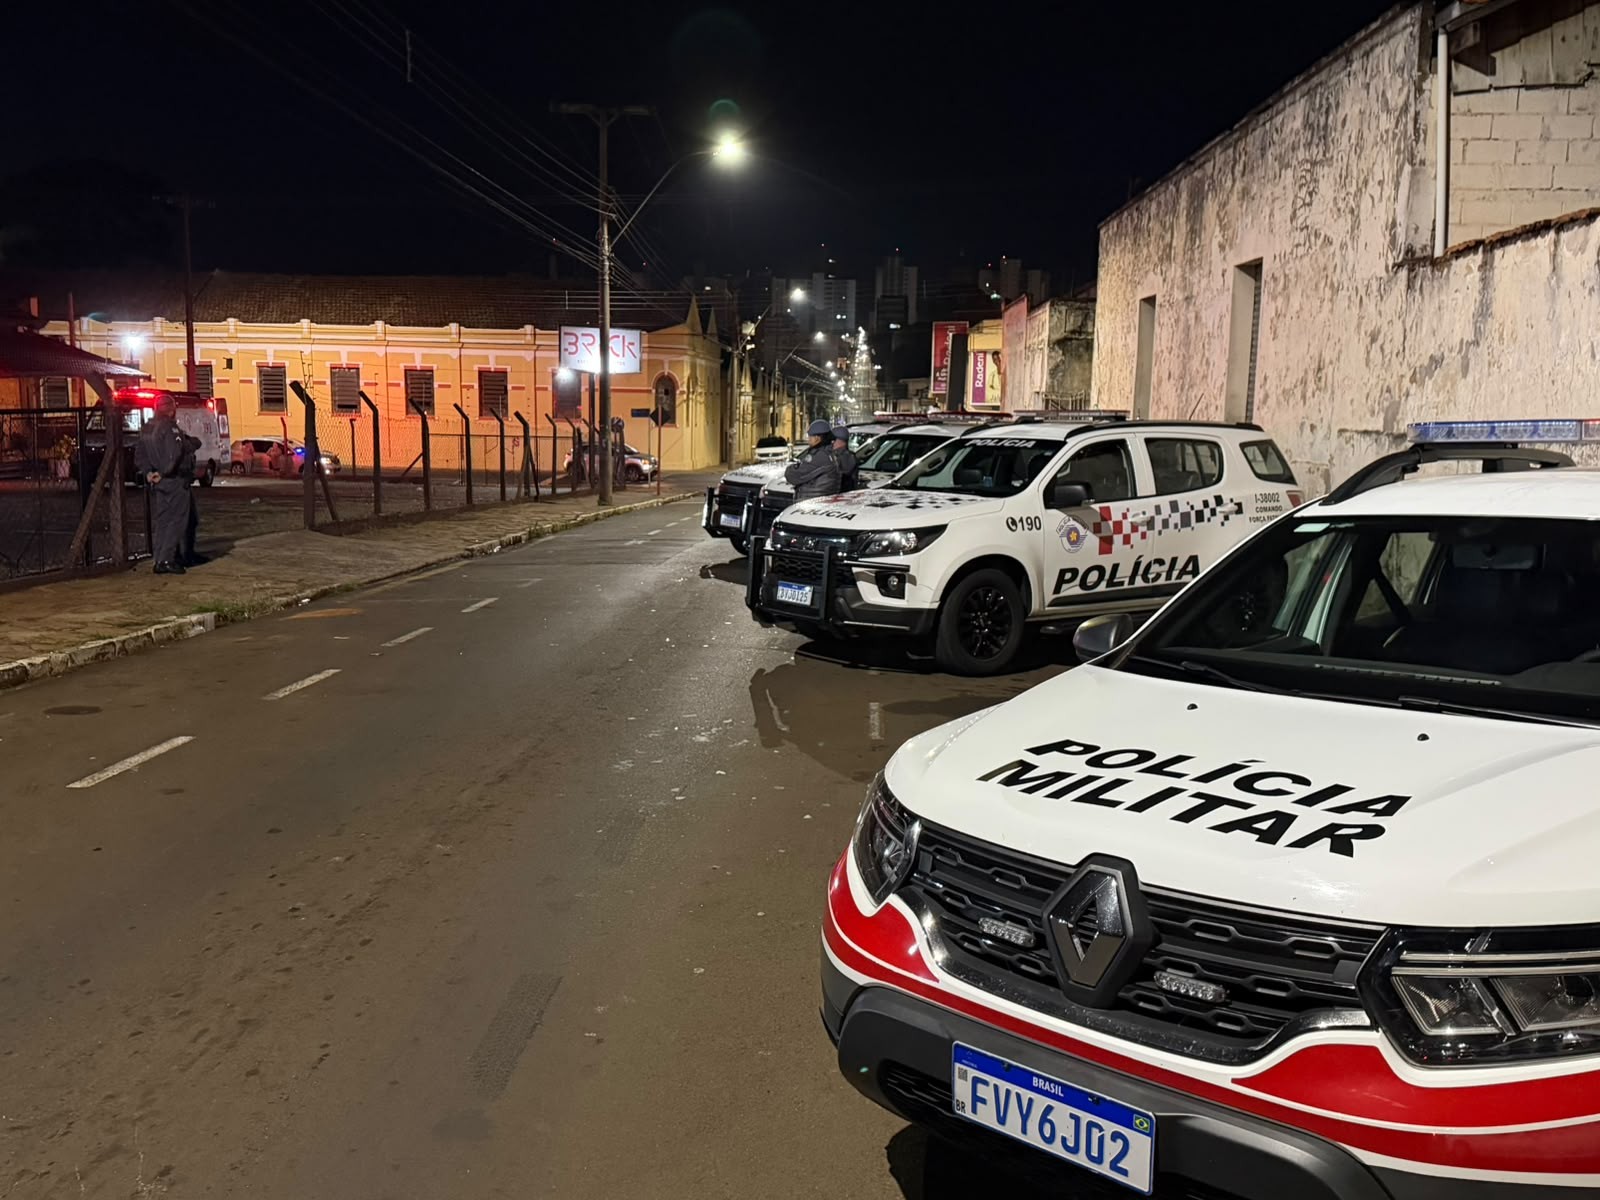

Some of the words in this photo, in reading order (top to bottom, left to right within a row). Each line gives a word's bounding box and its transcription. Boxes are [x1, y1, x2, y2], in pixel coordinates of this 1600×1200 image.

[1018, 515, 1042, 532] 190
[1255, 505, 1283, 513] COMANDO
[1052, 554, 1200, 596] POLÍCIA
[1023, 738, 1413, 818] POLÍCIA
[975, 758, 1387, 858] MILITAR
[1032, 1076, 1065, 1098] BRASIL
[955, 1098, 967, 1114] BR
[971, 1075, 1130, 1178] FVY6J02
